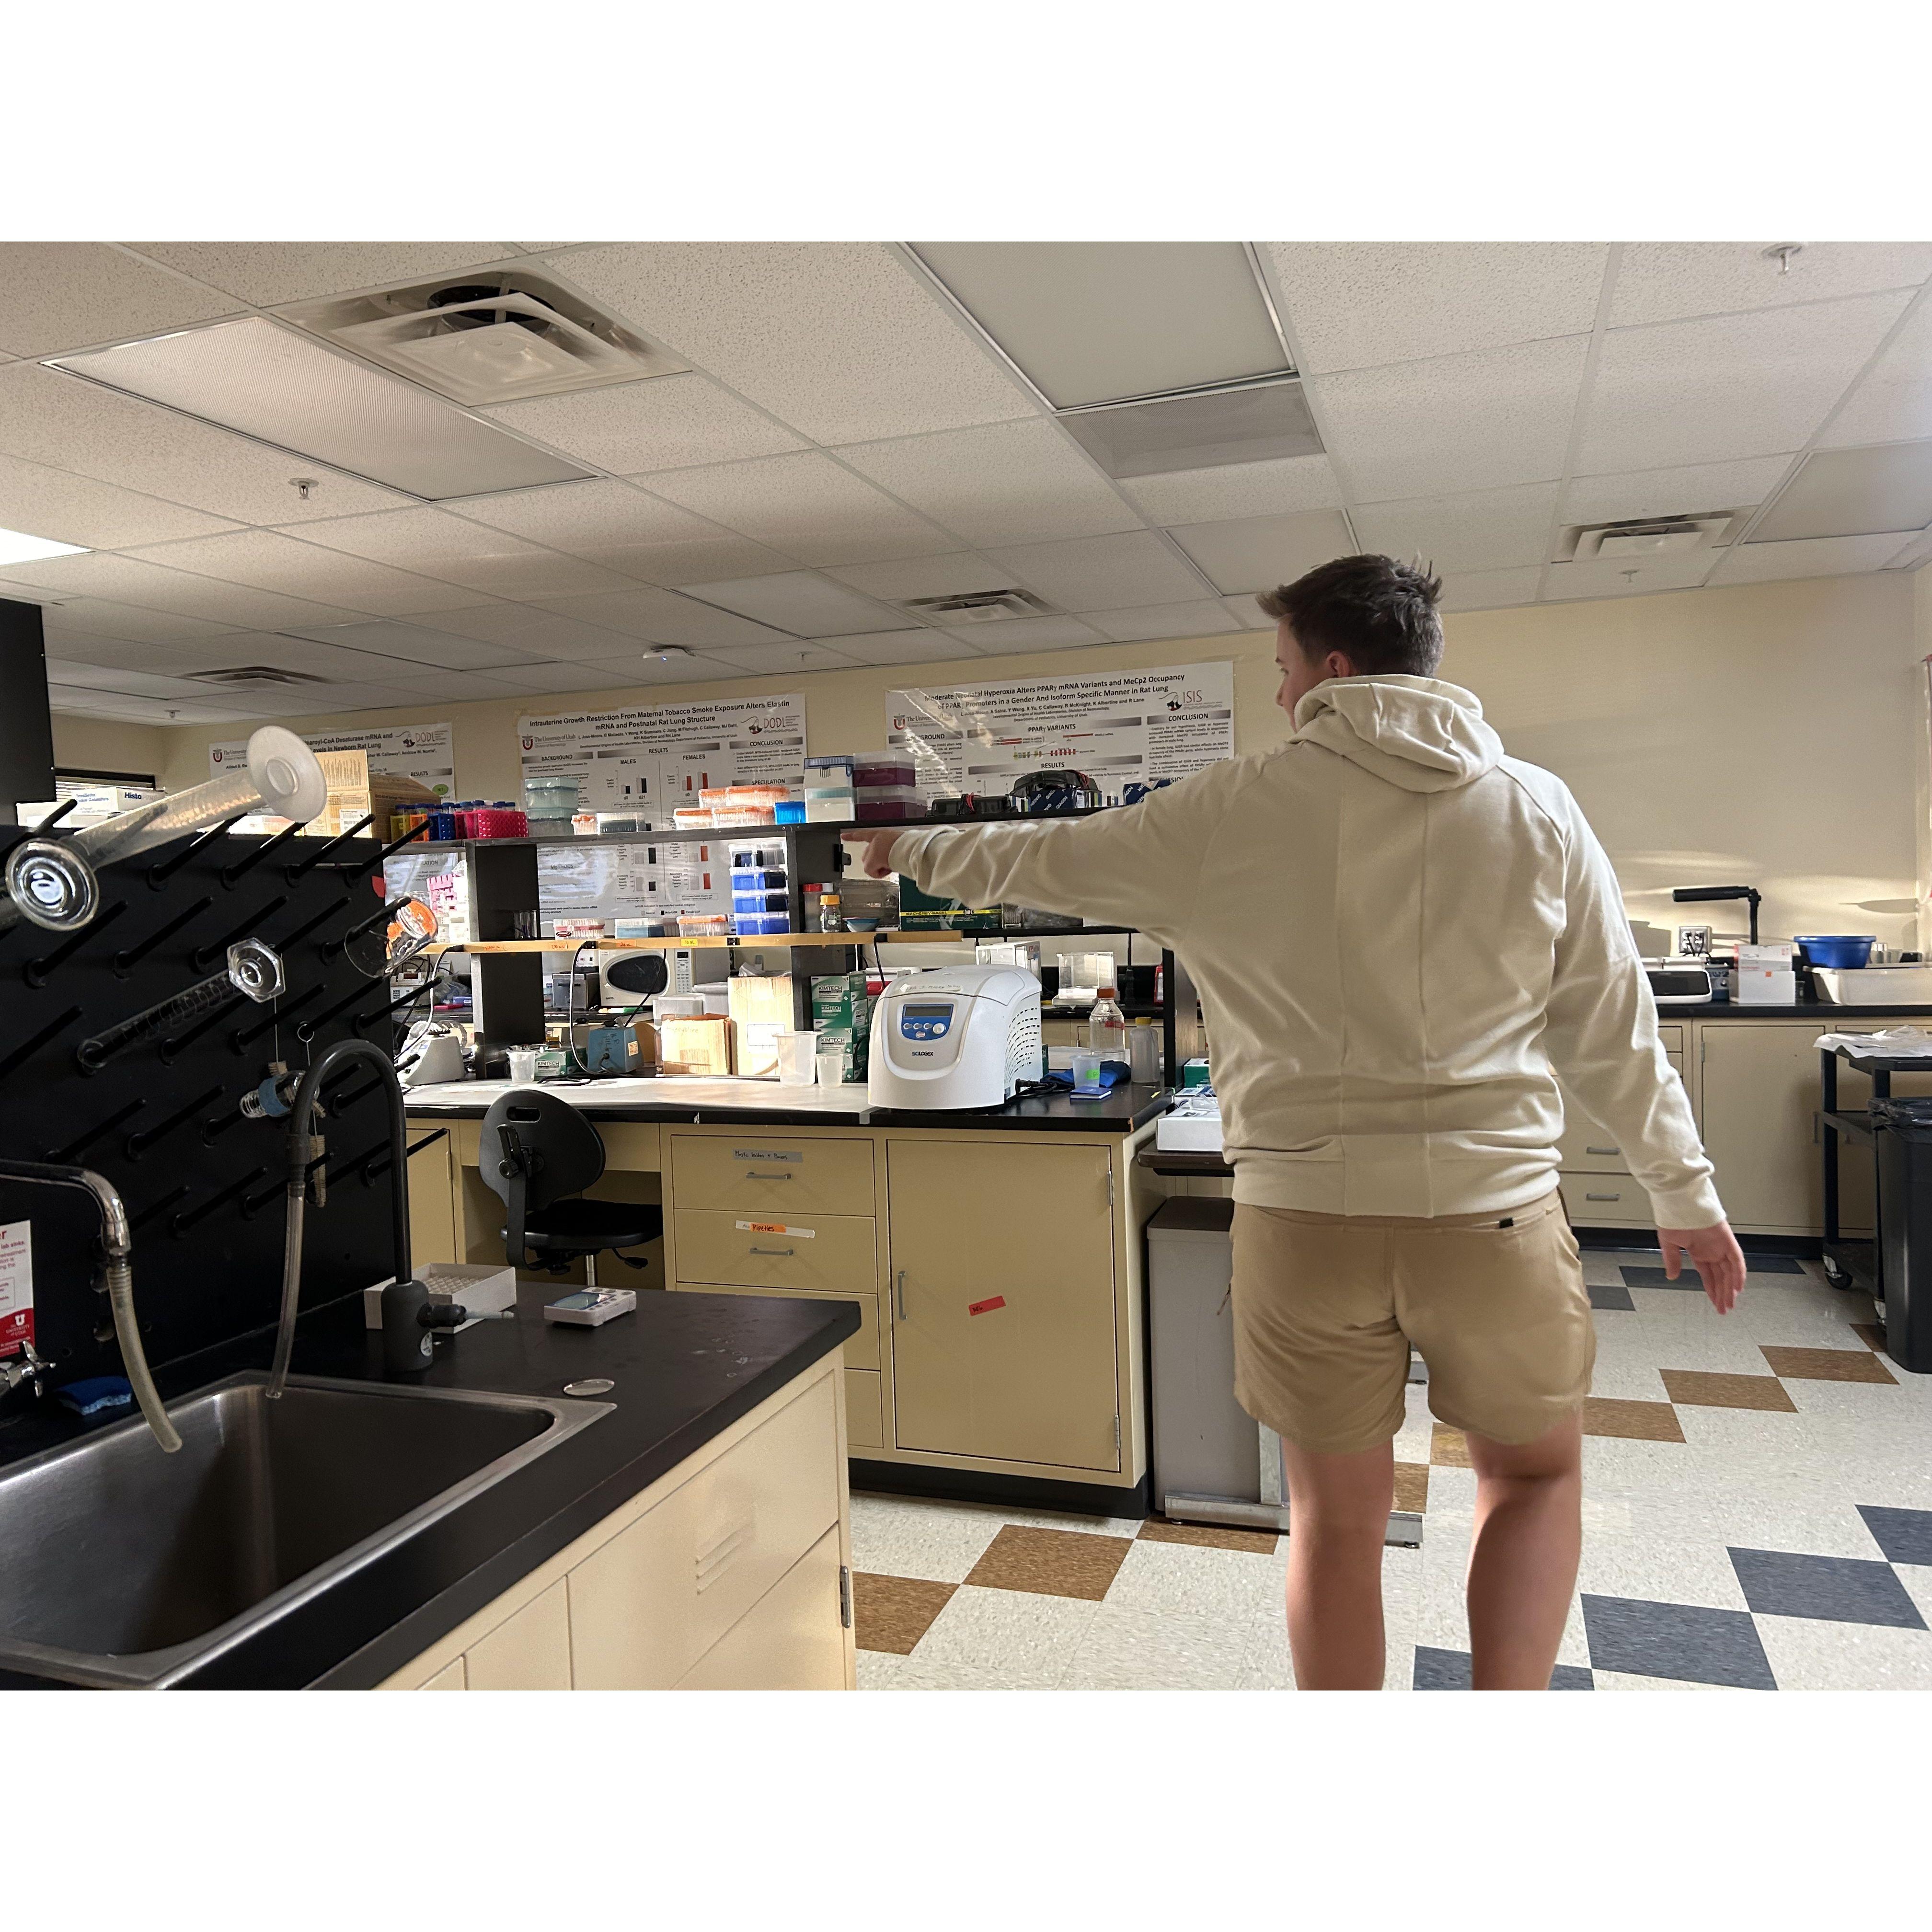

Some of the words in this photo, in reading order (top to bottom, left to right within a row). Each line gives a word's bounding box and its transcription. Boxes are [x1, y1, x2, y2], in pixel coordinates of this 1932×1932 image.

[984, 690, 1015, 698] Hyperoxia
[1149, 674, 1184, 683] Occupancy
[966, 700, 997, 708] Promoters
[1077, 691, 1102, 700] Specific
[1183, 690, 1202, 703] ISIS
[530, 719, 563, 727] Intrauterine
[638, 709, 664, 718] Maternal
[714, 704, 744, 712] Exposure
[629, 720, 657, 728] Postnatal
[670, 717, 686, 725] Lung
[687, 715, 715, 723] Structure
[1168, 713, 1208, 722] CONCLUSION
[124, 792, 142, 800] Histo
[1056, 795, 1068, 809] QIAGEN
[752, 1224, 775, 1232] Pipettes
